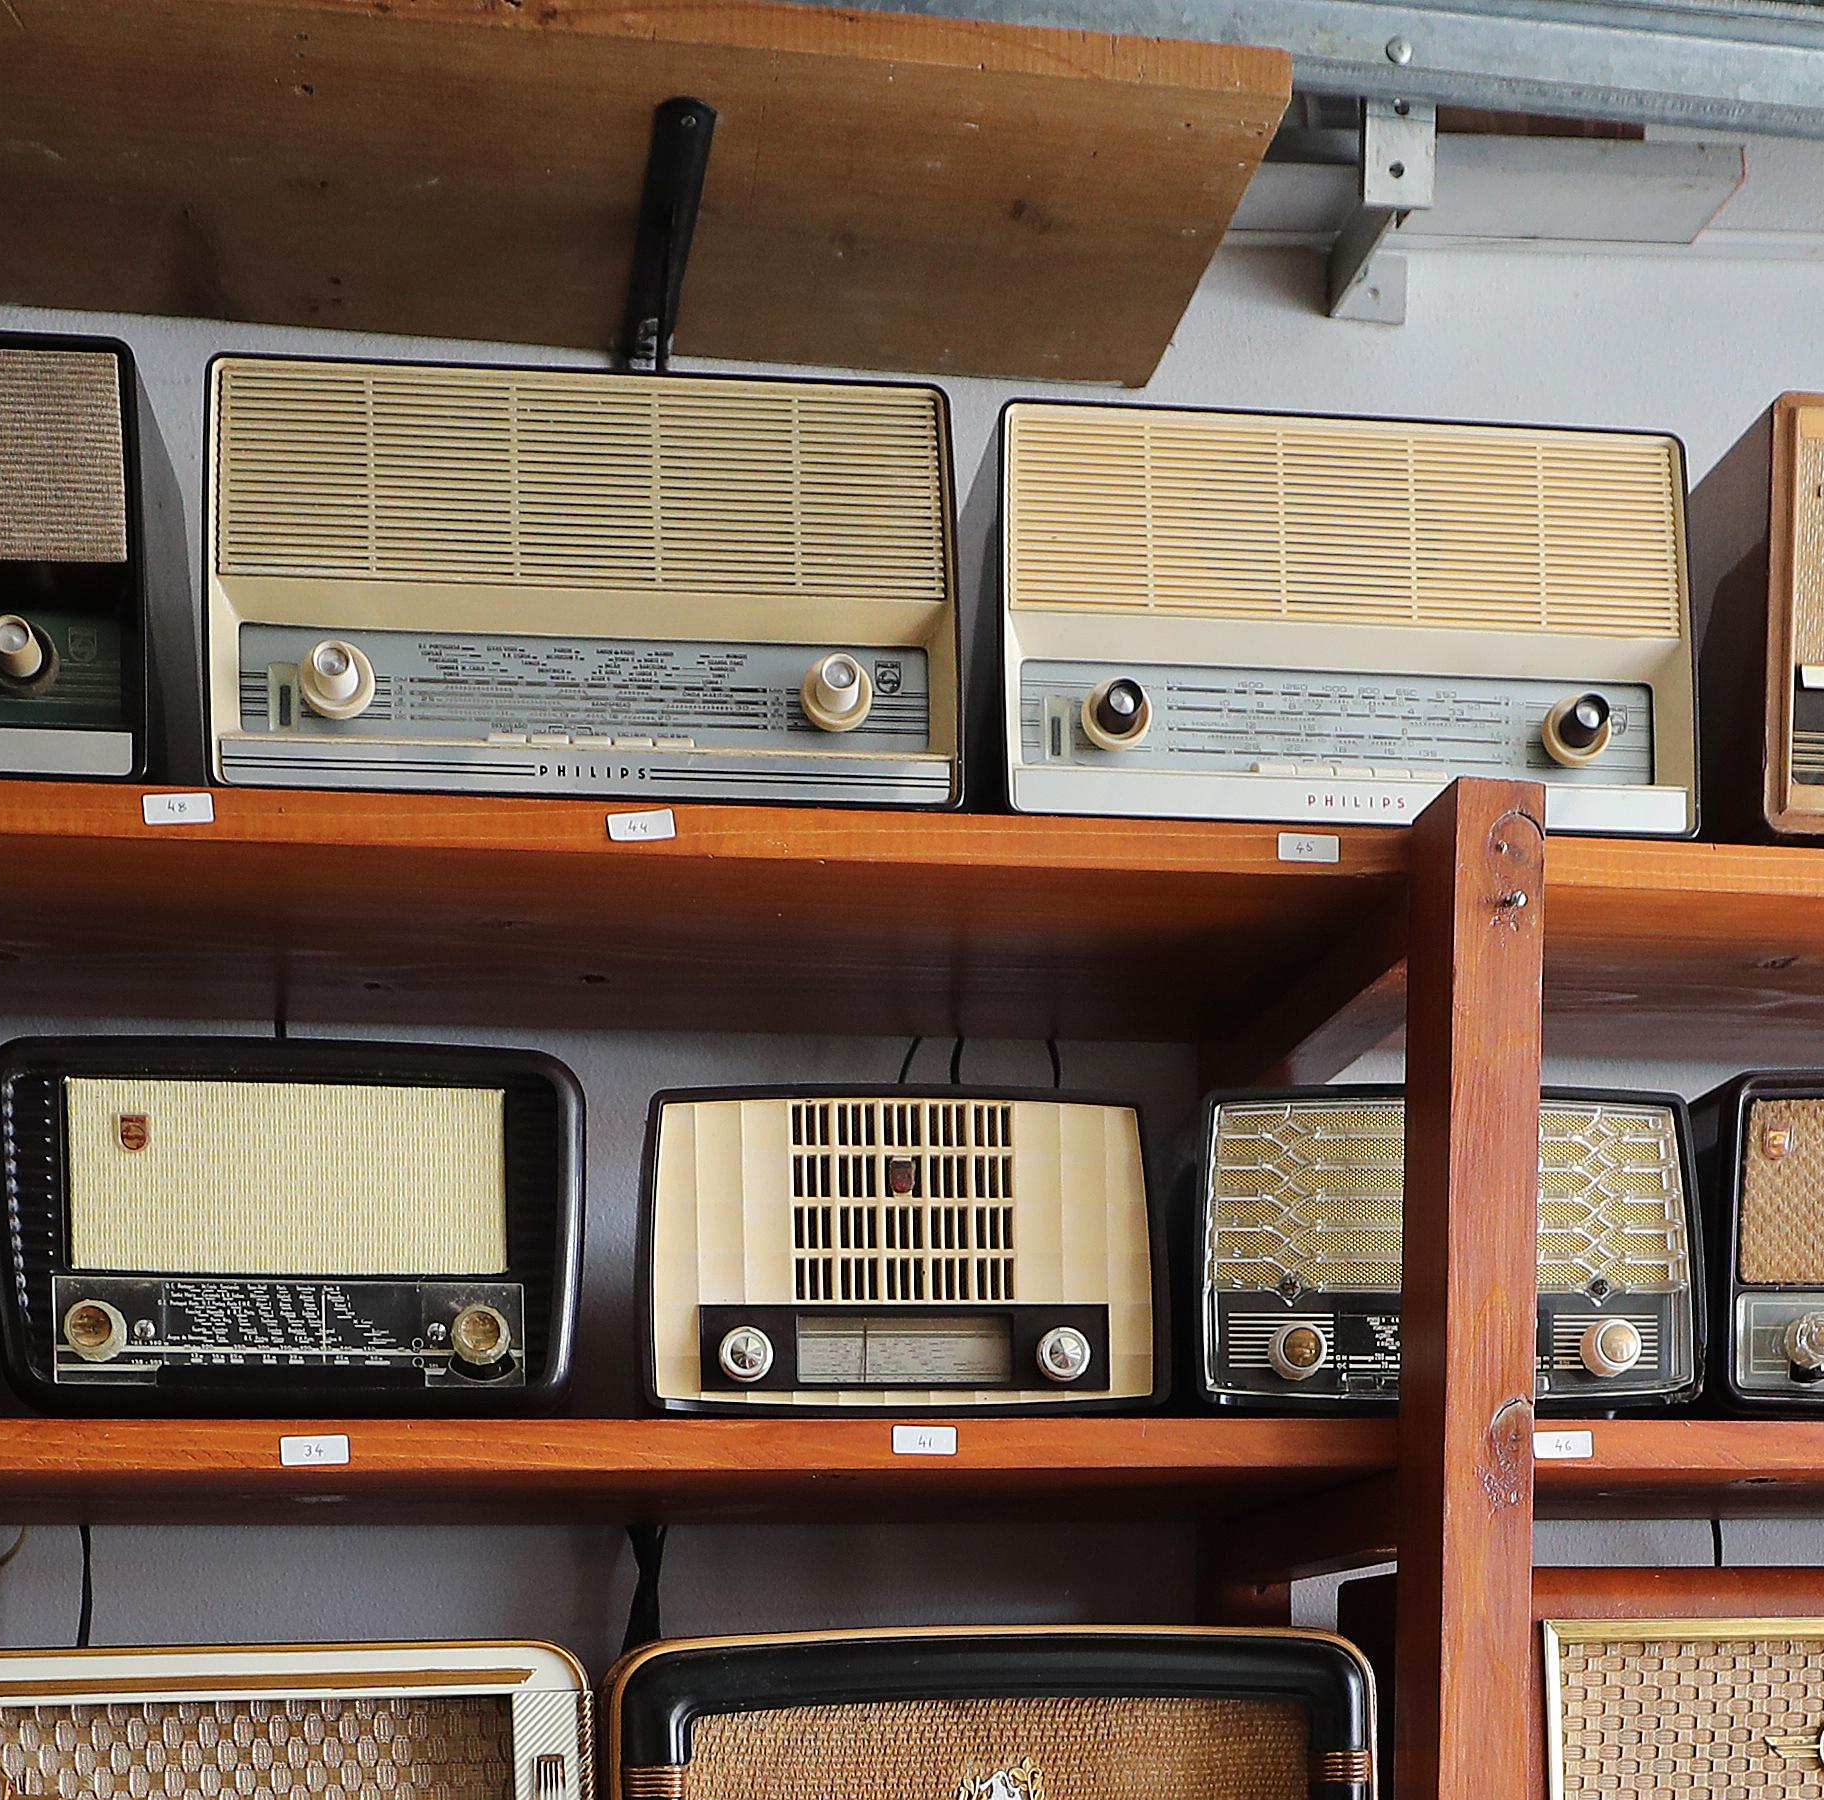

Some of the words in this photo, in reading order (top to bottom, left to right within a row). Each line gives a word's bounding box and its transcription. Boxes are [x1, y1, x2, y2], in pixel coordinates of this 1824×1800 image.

[539, 765, 646, 780] PHILIPS
[167, 799, 187, 814] 48
[1307, 794, 1406, 809] PHILIPS
[627, 818, 649, 834] 44
[1295, 840, 1315, 854] 45
[303, 1444, 325, 1458] 34
[1554, 1438, 1573, 1452] 46
